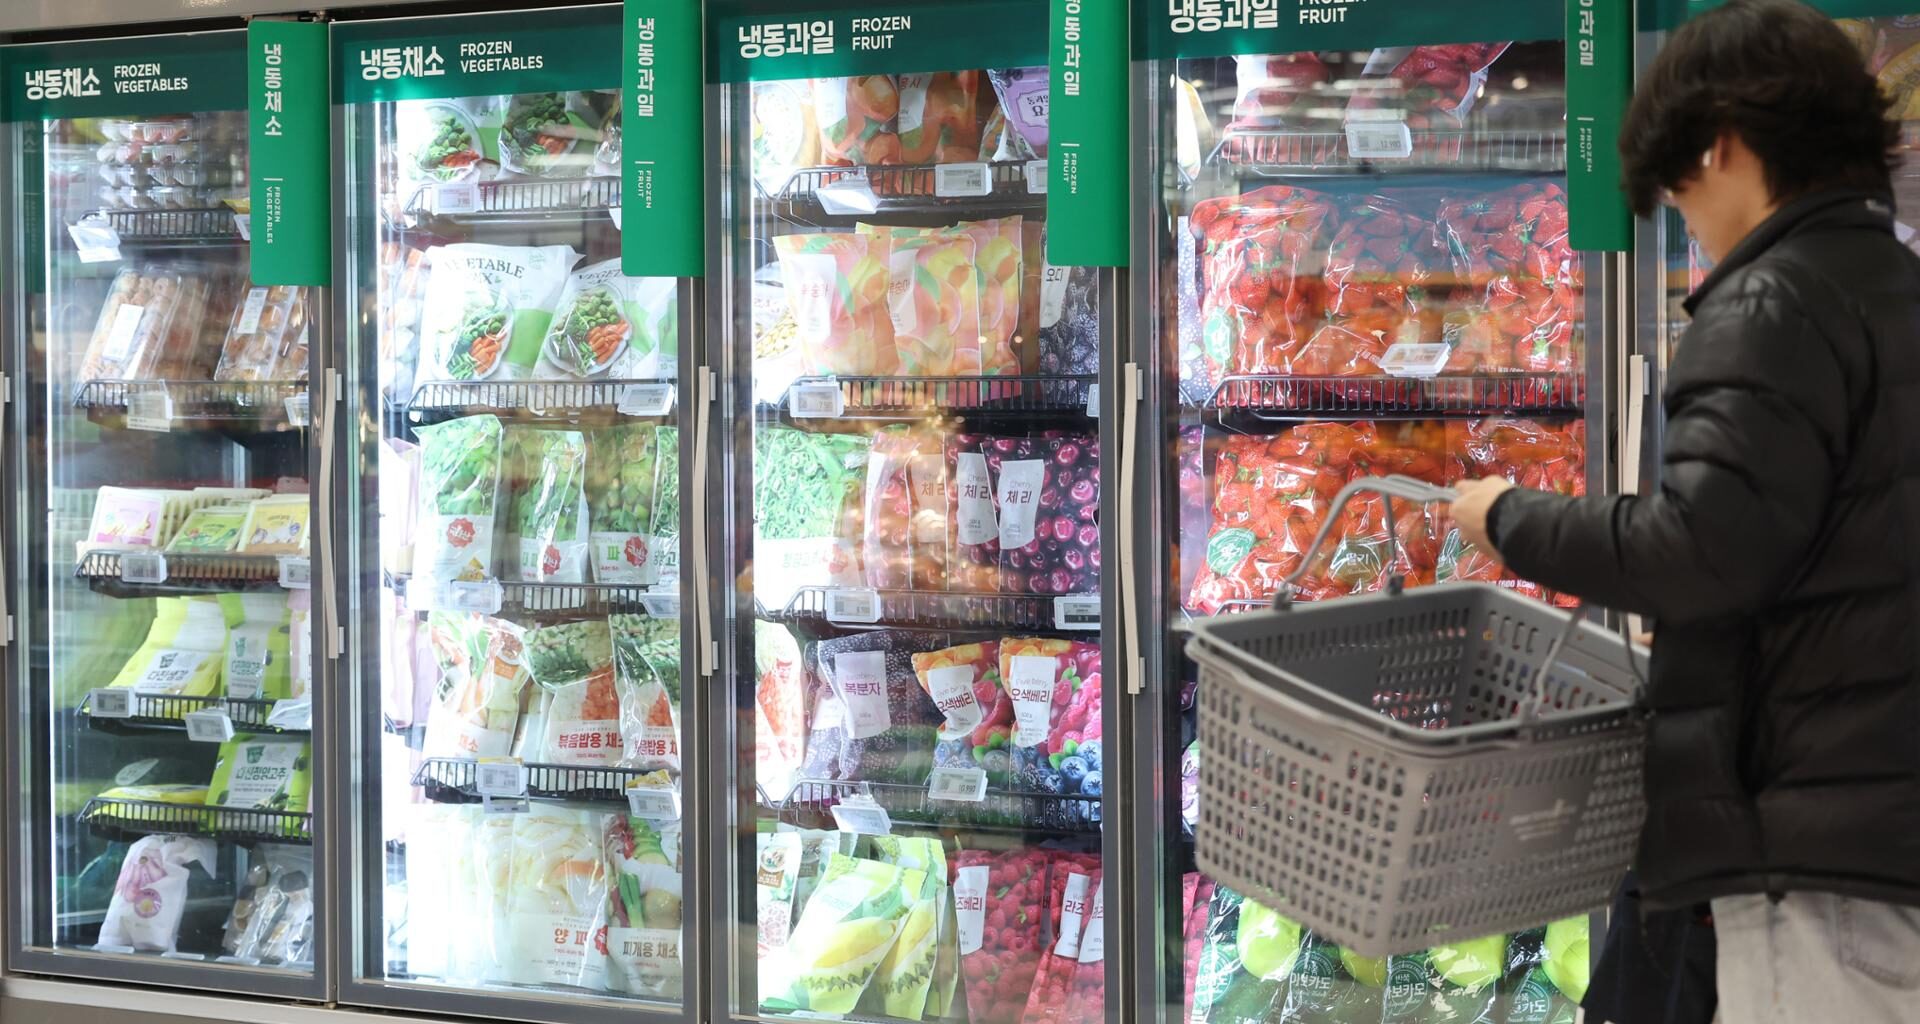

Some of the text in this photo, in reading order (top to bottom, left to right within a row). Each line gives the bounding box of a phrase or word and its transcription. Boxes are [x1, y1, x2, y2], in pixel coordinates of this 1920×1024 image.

[852, 15, 911, 32] FROZEN
[1168, 0, 1278, 34] 냉동과일
[1299, 8, 1348, 24] FRUIT
[738, 19, 835, 59] 냉동과일
[852, 34, 895, 50] FRUIT
[460, 40, 513, 56] FROZEN
[113, 63, 161, 79] FROZEN
[360, 46, 446, 81] 냉동채소
[460, 55, 543, 73] VEGETABLES
[637, 17, 655, 117] 냉동과일
[25, 67, 102, 100] 냉동채소
[113, 77, 189, 94] VEGETABLES
[264, 43, 283, 136] 냉동채소
[1070, 152, 1078, 193] FROZEN
[273, 186, 281, 222] FROZEN
[443, 257, 526, 280] VEETABLE
[1005, 490, 1032, 504] 체리
[1346, 553, 1369, 566] 딸기
[845, 682, 880, 696] 복분자
[1011, 688, 1050, 703] 오색베리
[937, 692, 975, 713] 오색베리
[558, 732, 602, 750] 볶음밥용
[956, 896, 983, 912] 즈베리
[1064, 900, 1085, 916] 라즈
[554, 928, 570, 945] 양
[622, 940, 655, 958] 찌개용
